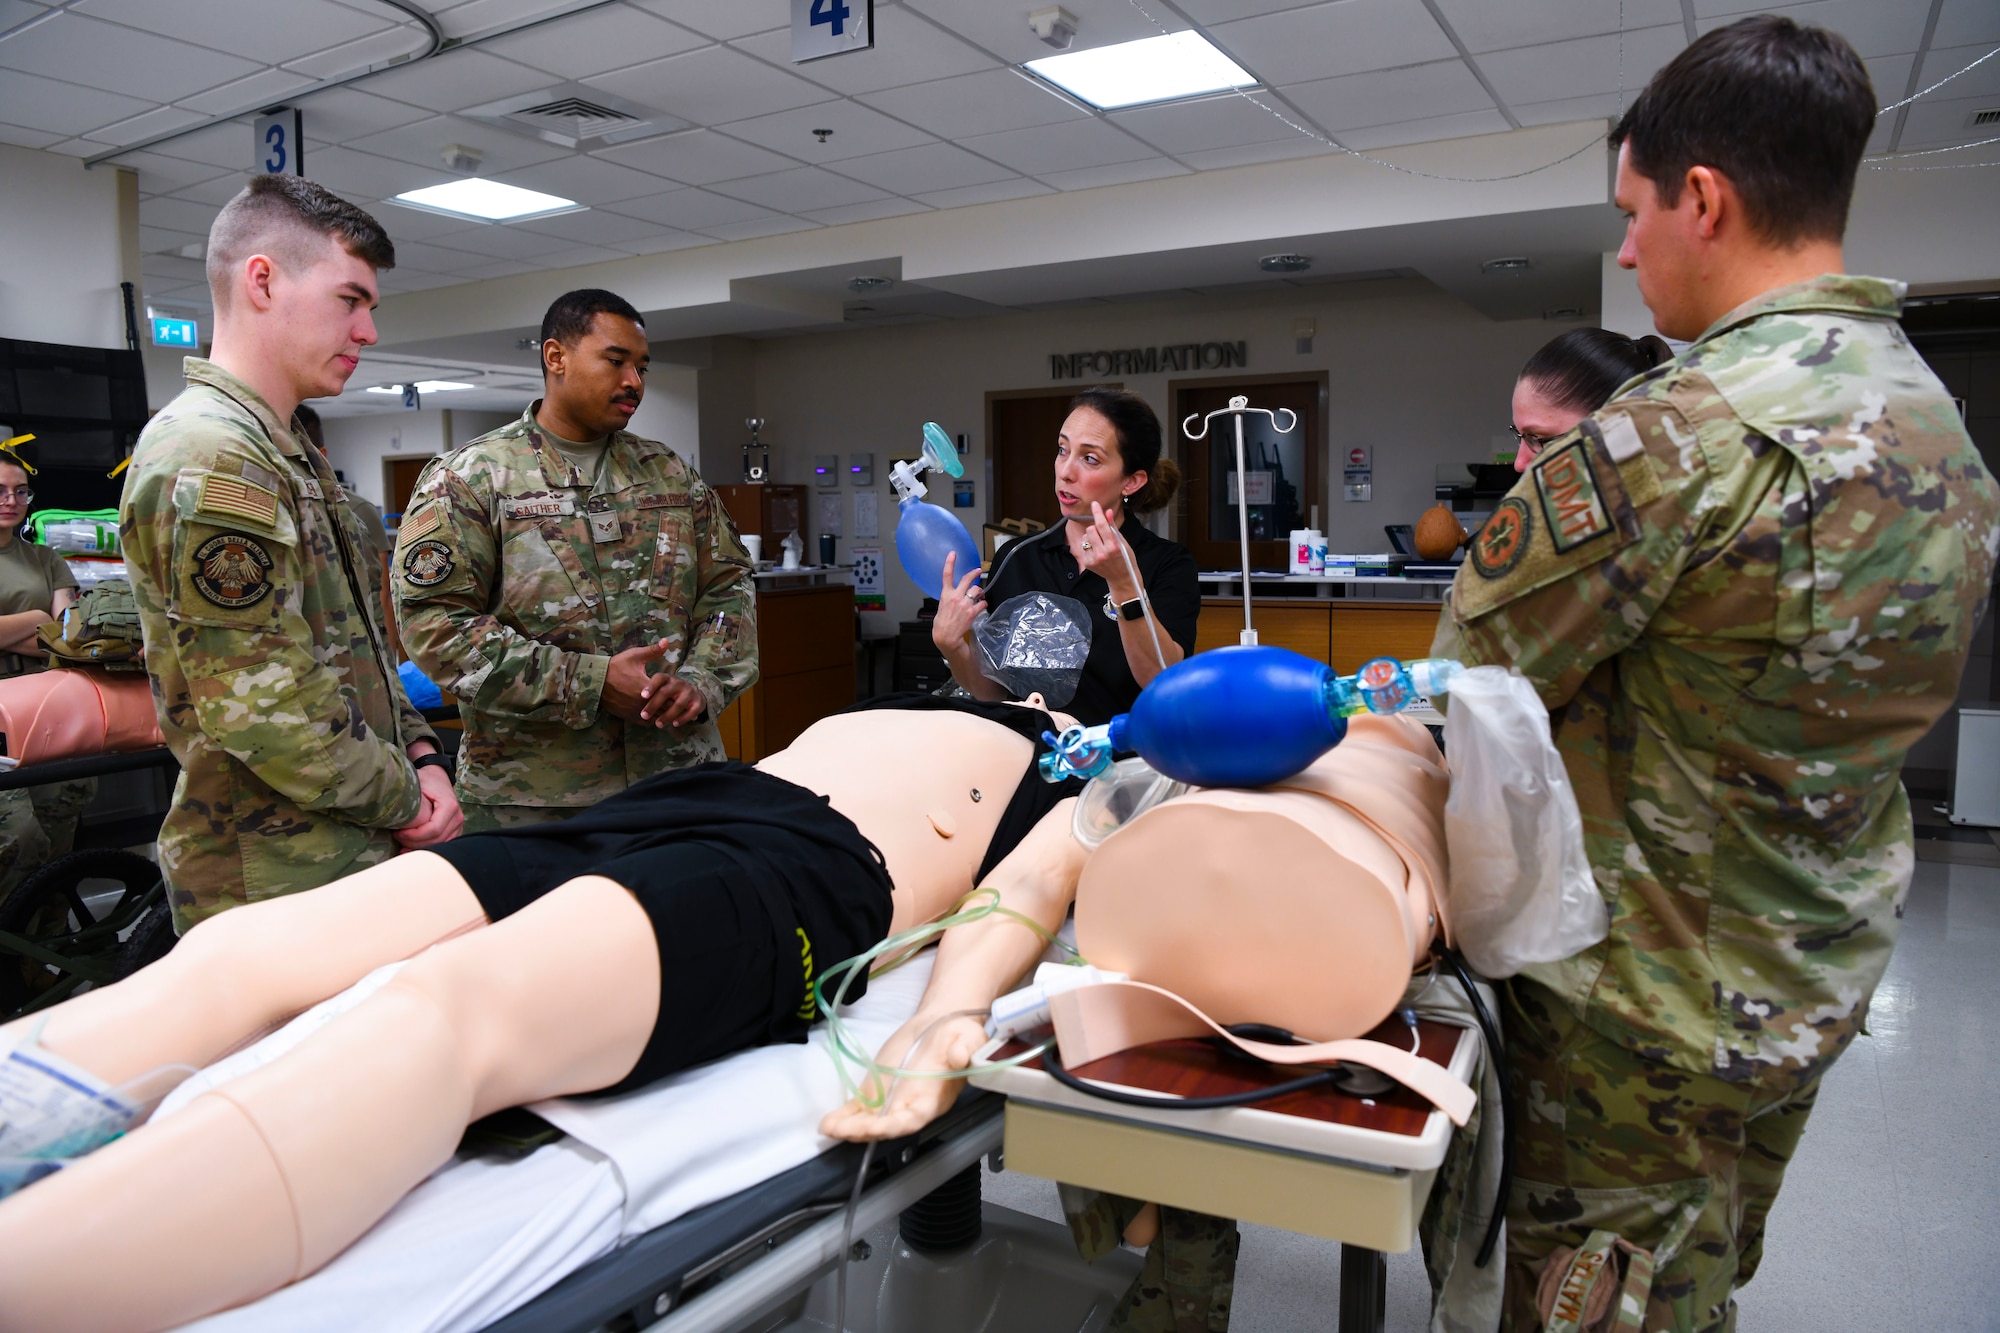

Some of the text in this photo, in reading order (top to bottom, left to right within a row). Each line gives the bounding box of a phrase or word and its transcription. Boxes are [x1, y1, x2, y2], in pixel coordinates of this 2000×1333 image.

[810, 0, 850, 37] 4
[265, 124, 286, 173] 3
[1049, 340, 1247, 380] INFORMATION
[406, 389, 414, 406] 2
[515, 503, 561, 516] GAITHER
[1543, 452, 1599, 536] IDMT
[1555, 1250, 1604, 1324] MATTAS
